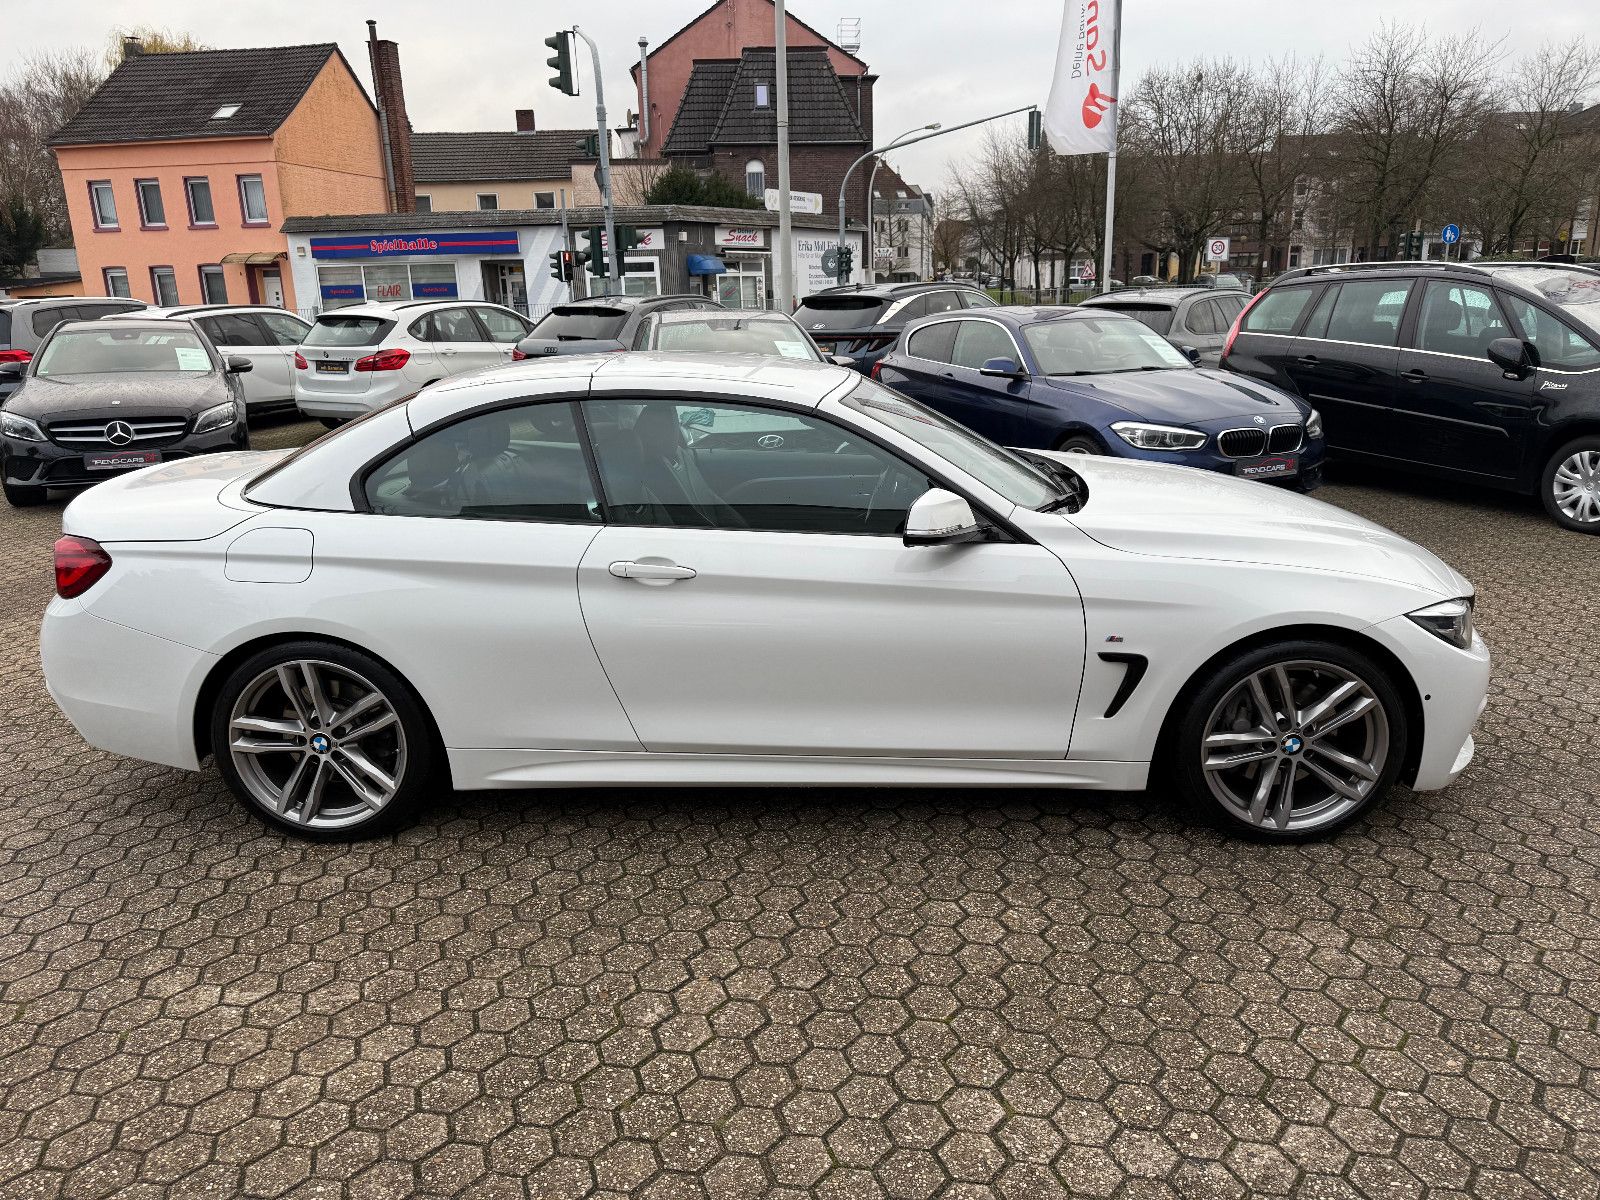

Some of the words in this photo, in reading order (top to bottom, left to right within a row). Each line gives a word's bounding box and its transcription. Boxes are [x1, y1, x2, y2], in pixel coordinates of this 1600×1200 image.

[722, 228, 759, 242] Snack
[370, 237, 438, 253] Spielhalle
[377, 284, 401, 297] FLAIR
